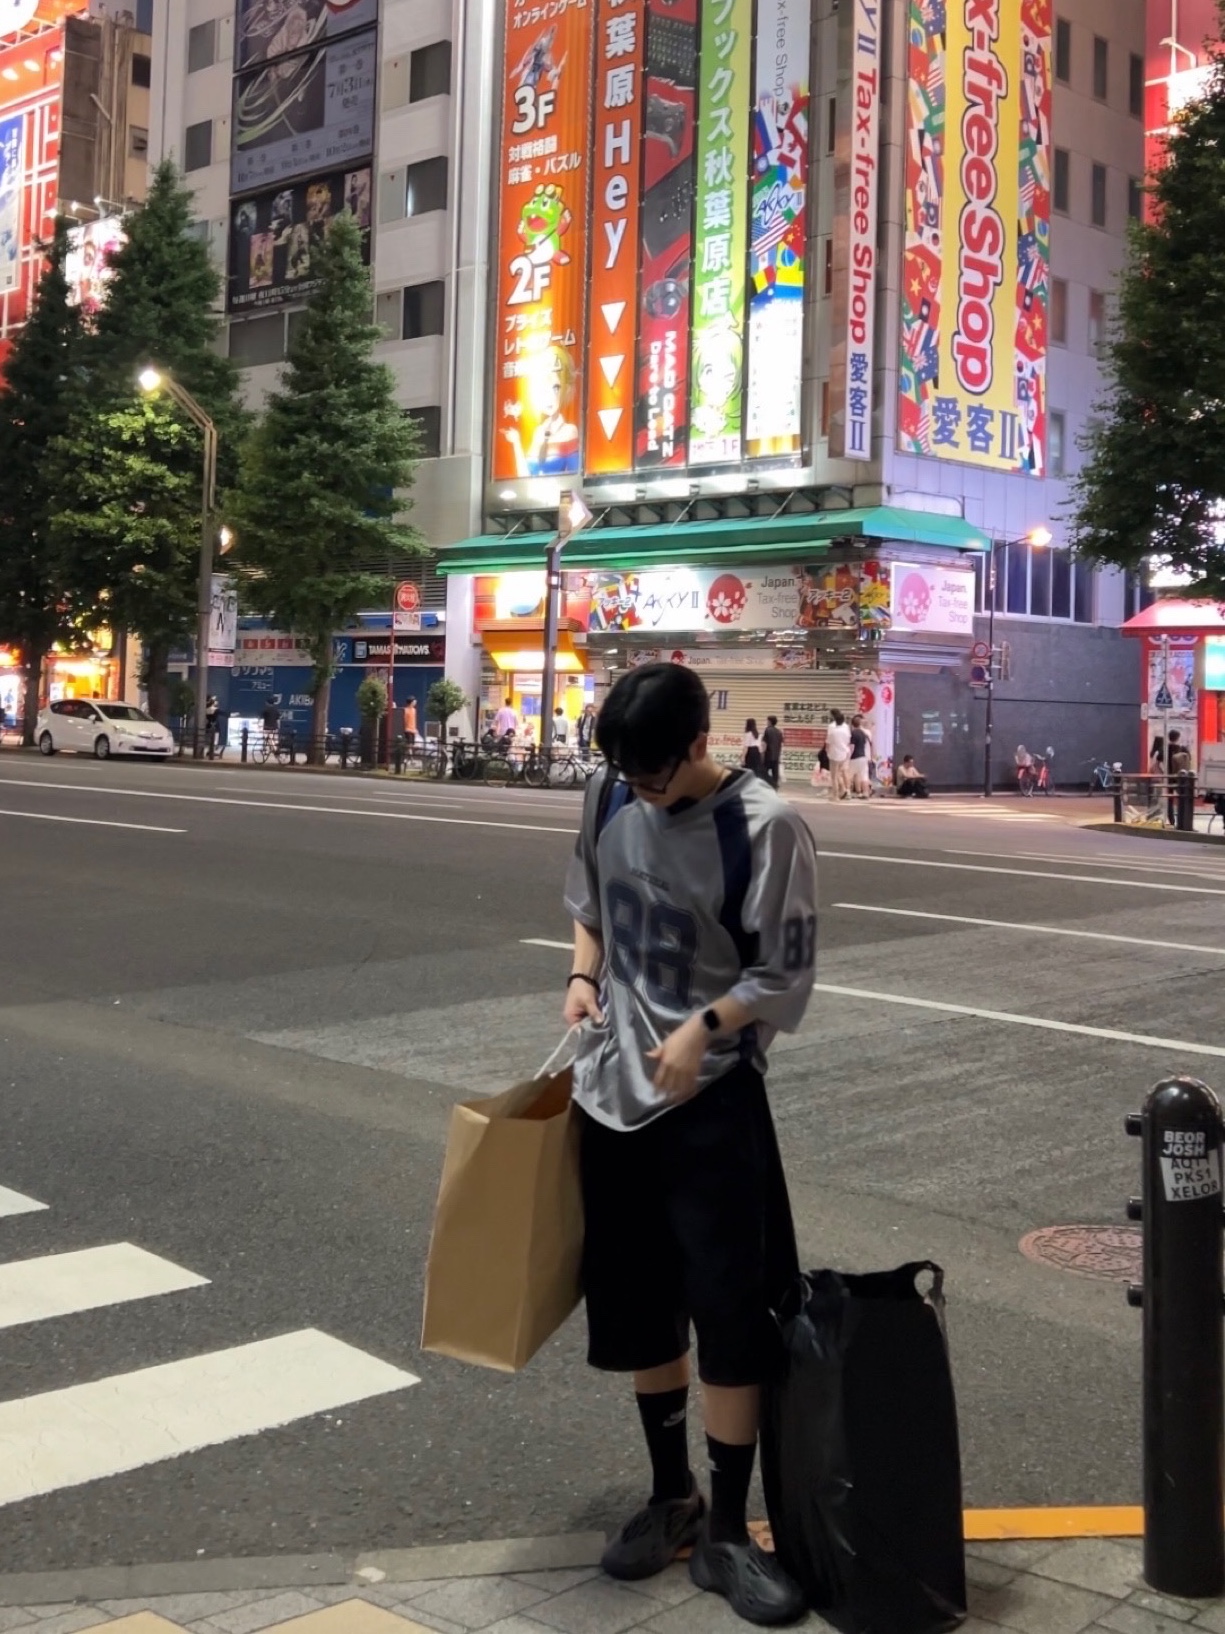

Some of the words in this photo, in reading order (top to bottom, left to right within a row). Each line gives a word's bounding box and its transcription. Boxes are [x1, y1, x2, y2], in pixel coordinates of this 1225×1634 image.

[511, 85, 556, 134] 3F
[853, 68, 878, 236] Tax-free
[506, 255, 551, 305] 2F
[850, 240, 873, 345] Shop
[954, 208, 1002, 387] Shop
[757, 591, 797, 604] Tax-free
[938, 595, 968, 610] Tax-free
[771, 606, 797, 620] Shop
[948, 611, 967, 625] Shop
[1164, 1130, 1206, 1144] BEOR
[1162, 1143, 1206, 1156] JOSH
